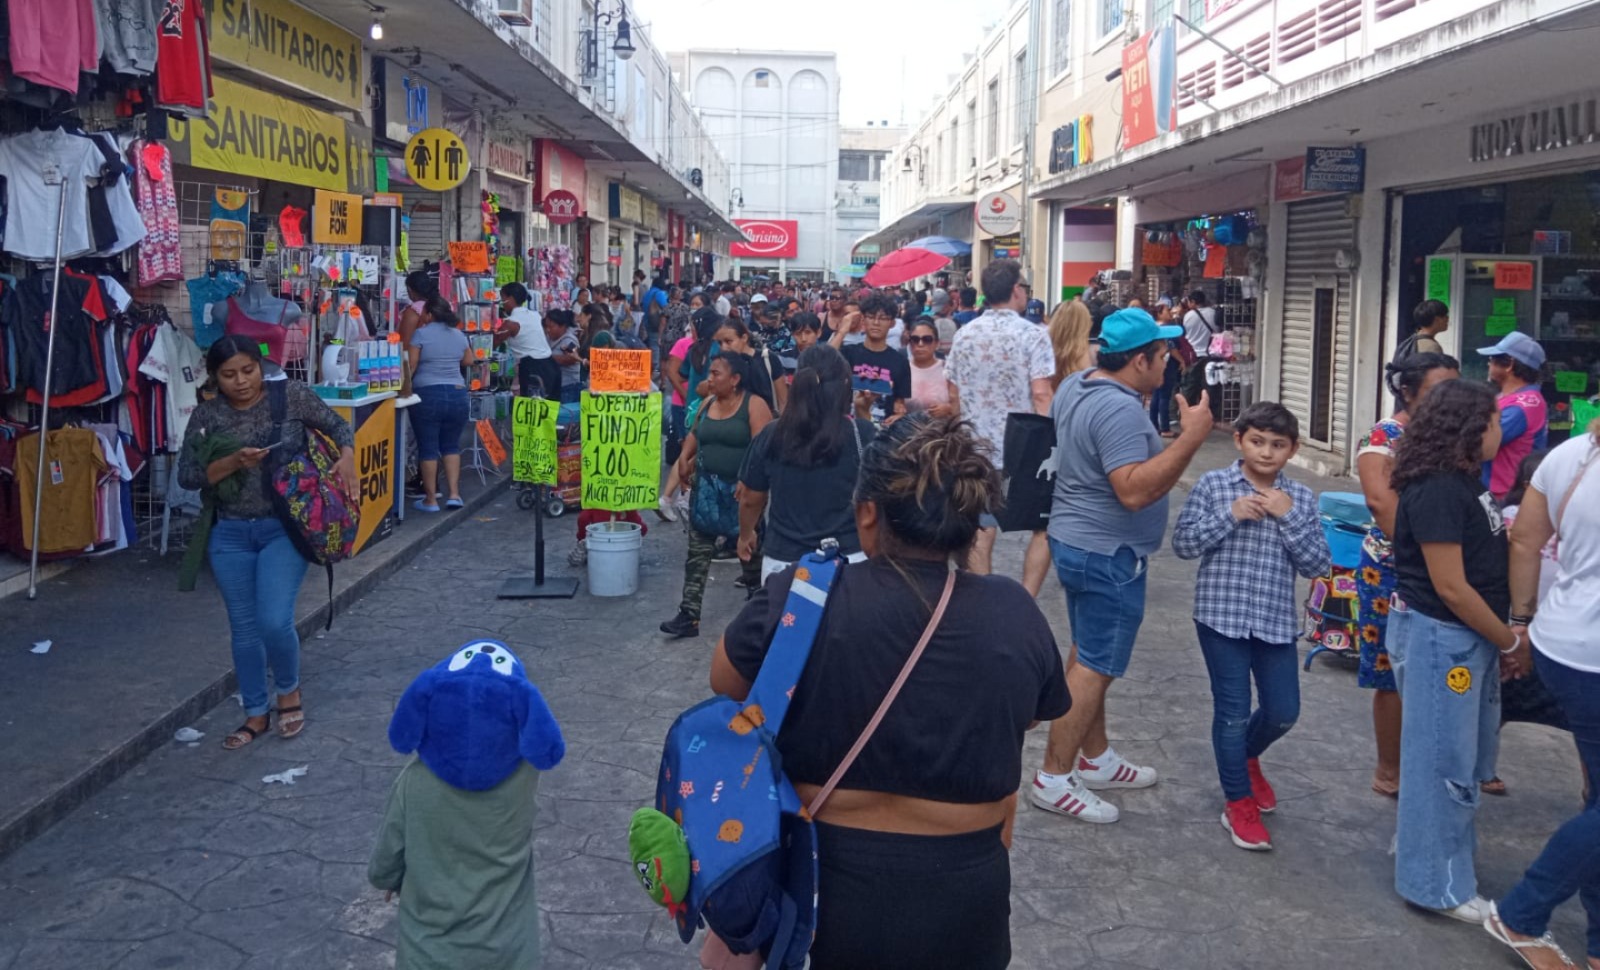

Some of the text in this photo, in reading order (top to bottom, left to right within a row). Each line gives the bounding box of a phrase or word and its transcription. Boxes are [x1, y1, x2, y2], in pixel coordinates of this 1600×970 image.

[222, 0, 345, 83] SANITARIOS
[1123, 57, 1147, 96] YETI
[203, 100, 339, 176] SANITARIOS
[330, 199, 348, 217] UNE
[329, 217, 347, 235] FON
[515, 400, 549, 427] CHIP
[595, 394, 647, 413] OFERTA
[587, 413, 650, 446] FUNDA
[361, 439, 388, 475] UNE
[360, 468, 388, 507] FON
[585, 482, 657, 507] MICA GRATIS
